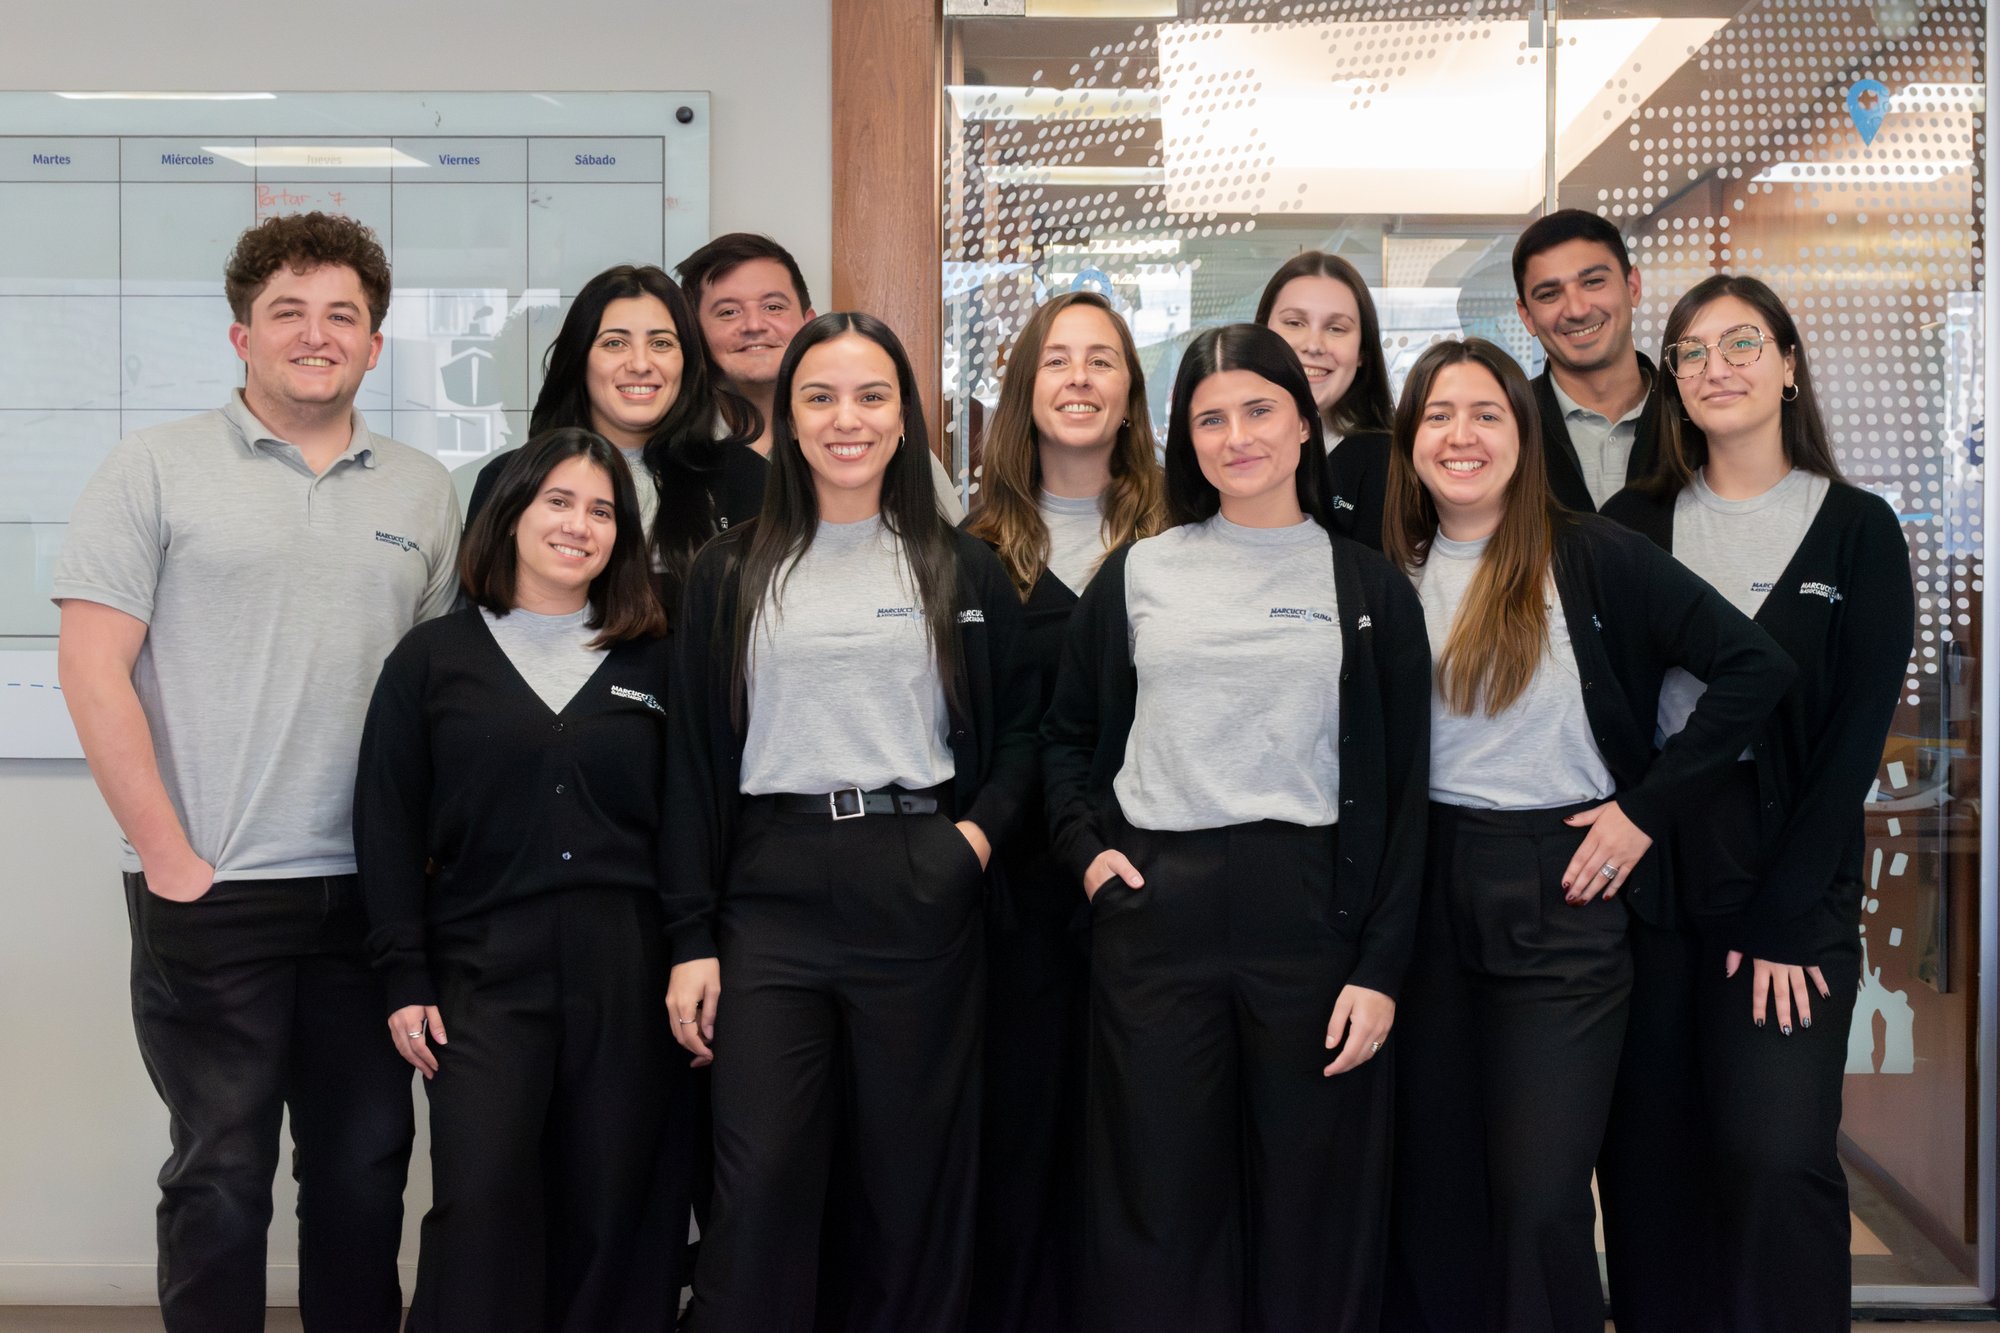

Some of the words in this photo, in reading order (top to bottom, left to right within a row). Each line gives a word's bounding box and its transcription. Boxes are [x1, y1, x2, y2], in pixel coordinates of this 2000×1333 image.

[32, 154, 71, 165] Martes
[161, 154, 214, 166] Miércoles
[439, 154, 480, 166] Viernes
[574, 154, 616, 166] Sábado
[1271, 608, 1306, 616] MARCUCCI
[1312, 612, 1332, 623] GUMA
